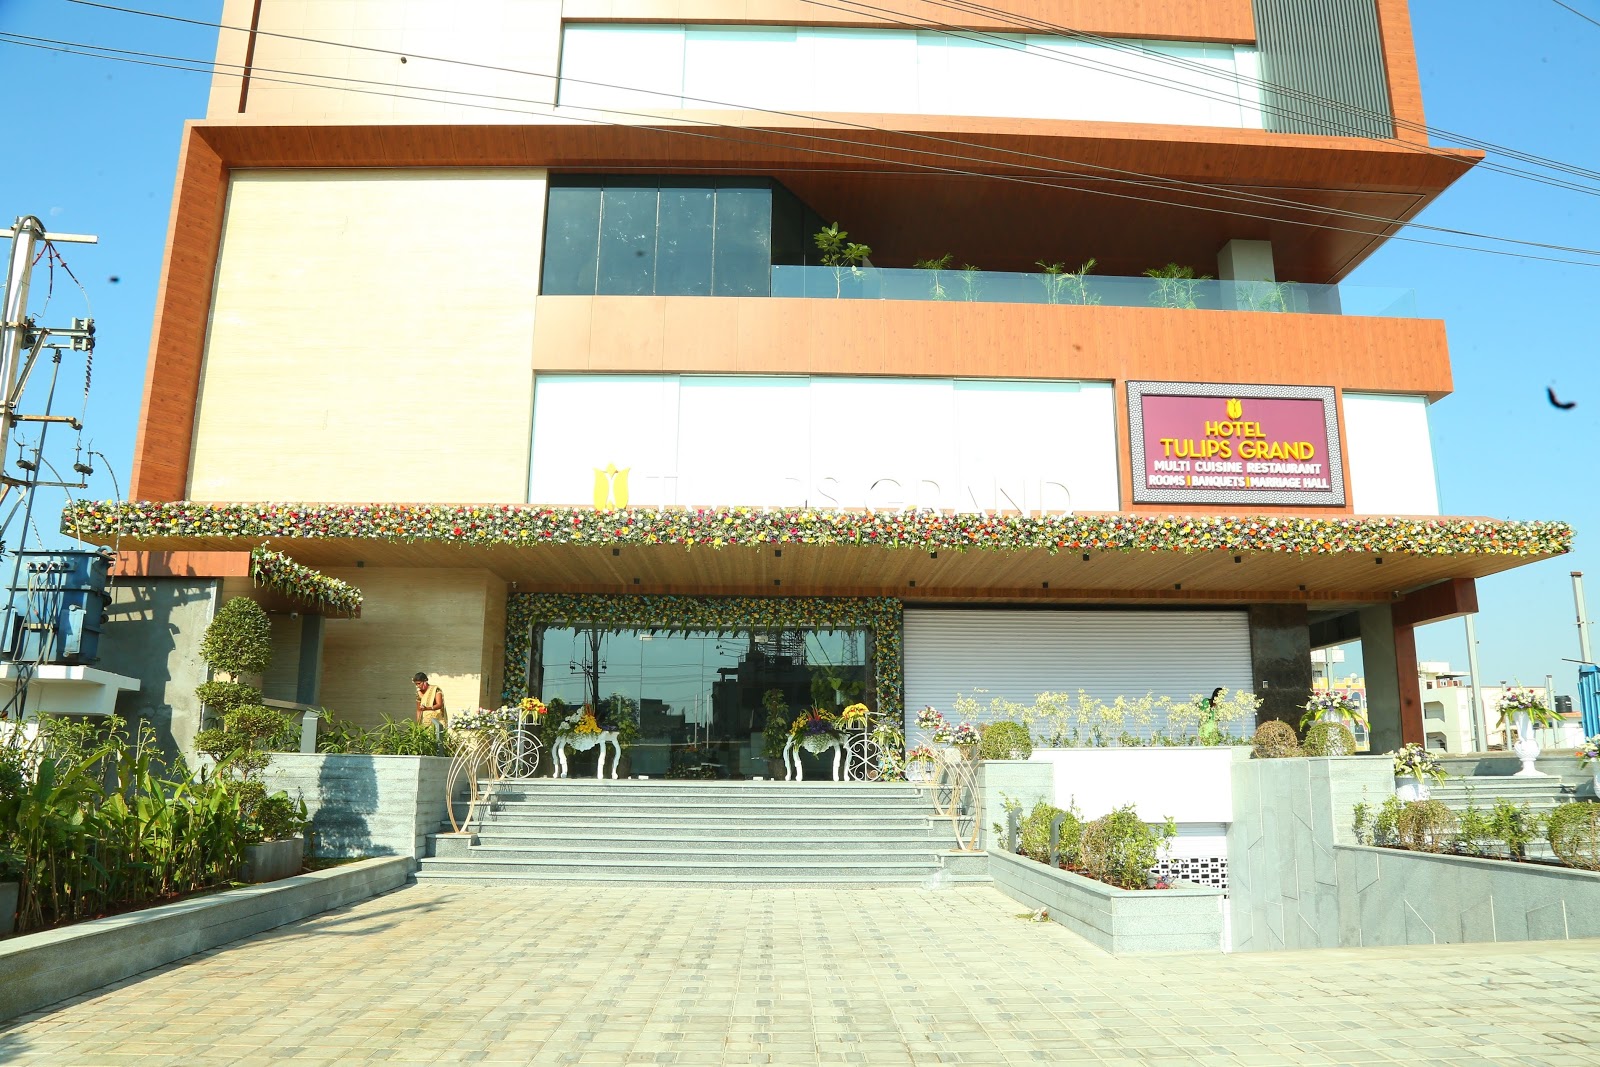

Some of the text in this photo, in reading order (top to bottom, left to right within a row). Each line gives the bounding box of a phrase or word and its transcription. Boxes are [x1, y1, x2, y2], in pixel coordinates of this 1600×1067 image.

[1205, 421, 1267, 438] HOTEL
[1160, 438, 1315, 460] TULIPS GRAND
[1153, 460, 1322, 475] MULTI CUISINE RESTAURANT
[1148, 474, 1330, 489] ROOMS BANQUETS MARRIAGE HALL
